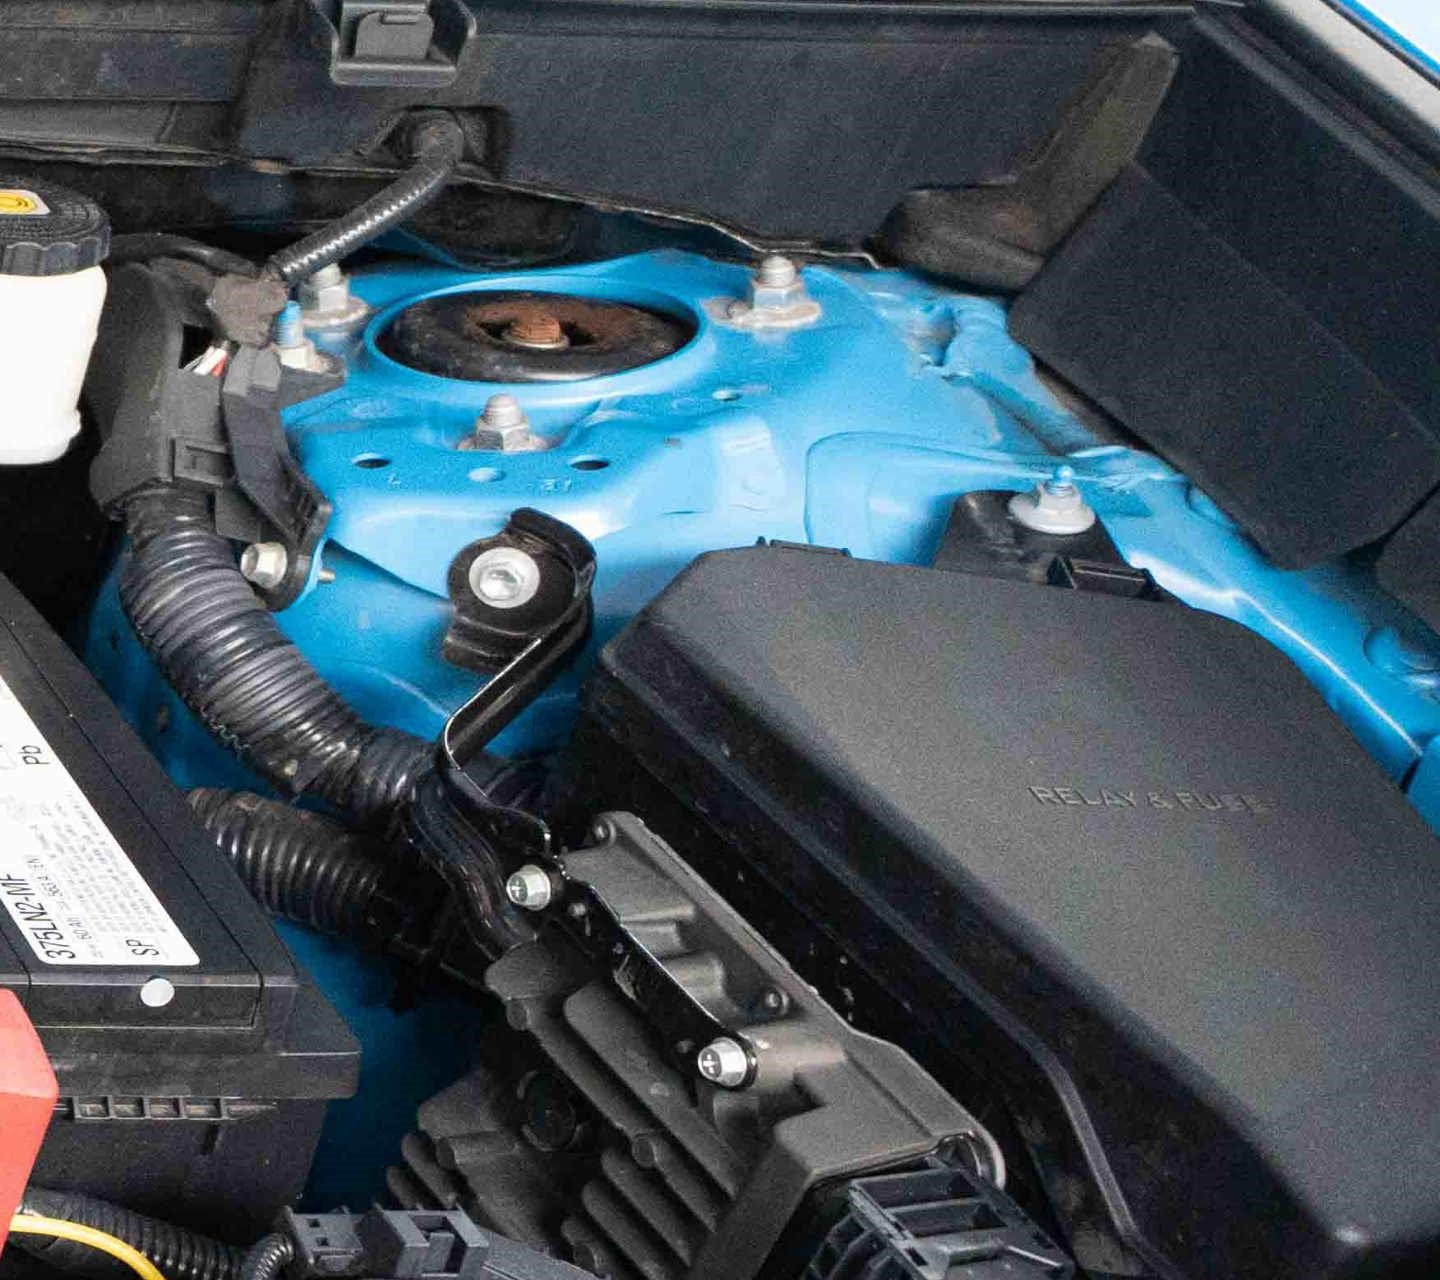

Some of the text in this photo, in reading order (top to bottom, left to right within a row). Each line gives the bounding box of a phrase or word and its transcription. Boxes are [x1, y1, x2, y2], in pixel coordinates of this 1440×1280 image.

[17, 744, 51, 765] Pb
[1027, 785, 1137, 809] RELAY
[125, 938, 160, 956] SP
